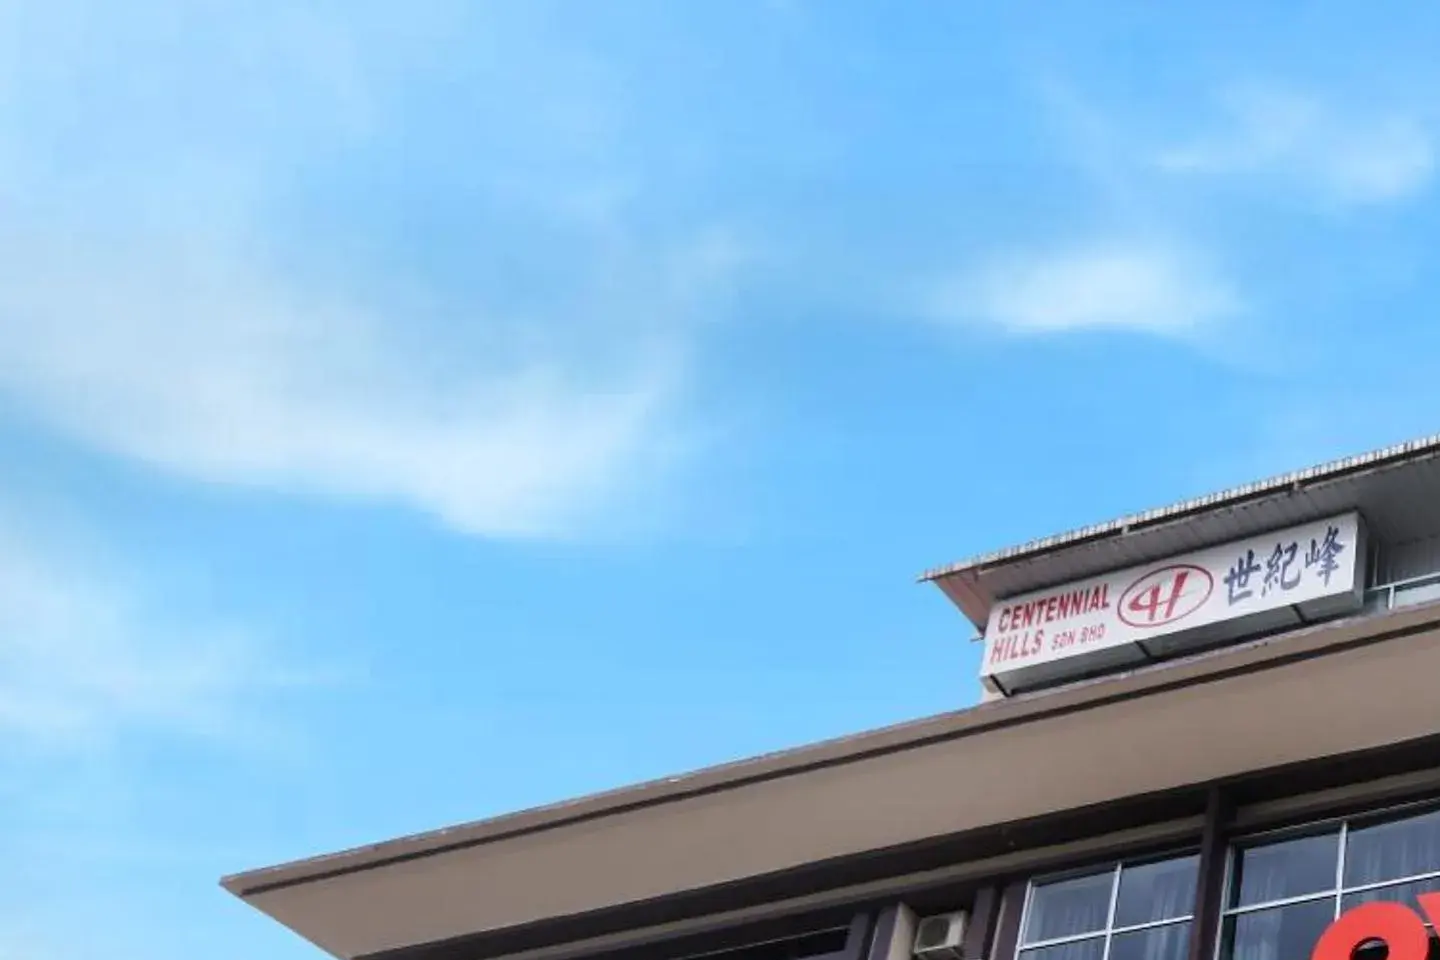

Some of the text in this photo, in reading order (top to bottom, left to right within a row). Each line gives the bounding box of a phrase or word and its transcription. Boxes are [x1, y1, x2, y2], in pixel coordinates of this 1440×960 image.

[1223, 526, 1344, 606] 世紀峰
[998, 583, 1109, 633] CENTENNIAL
[990, 629, 1044, 664] HILLS
